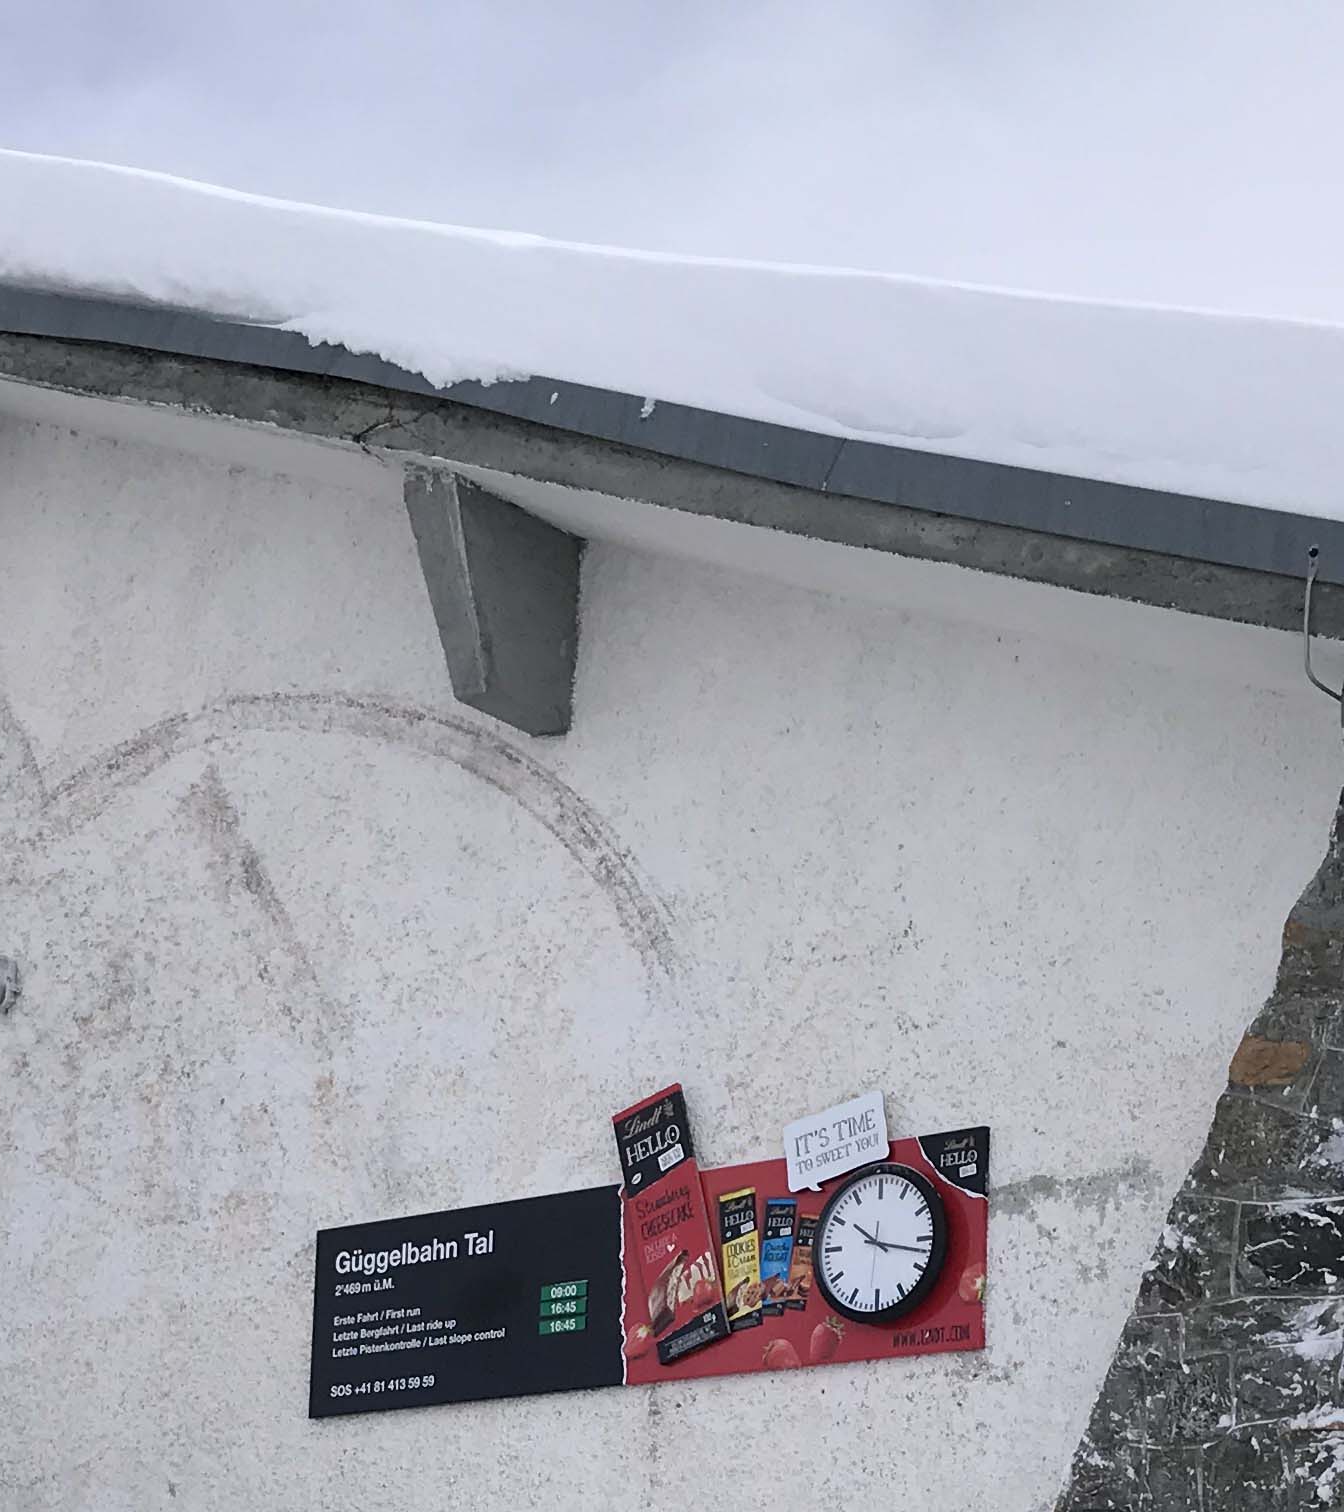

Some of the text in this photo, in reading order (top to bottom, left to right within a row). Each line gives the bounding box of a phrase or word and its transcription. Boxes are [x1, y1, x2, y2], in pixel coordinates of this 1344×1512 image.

[623, 1104, 662, 1140] Lindt
[793, 1108, 877, 1157] IT'S TIME
[626, 1124, 680, 1167] HELLO
[796, 1156, 814, 1175] TO
[816, 1142, 853, 1167] SWEET
[940, 1150, 978, 1167] HELLO
[724, 1210, 754, 1227] HELLO
[768, 1217, 794, 1227] HELLO
[335, 1230, 494, 1276] Güggelbahn Tal
[550, 1285, 577, 1298] 09:00
[333, 1315, 355, 1326] Erste
[357, 1312, 378, 1323] Fahrt
[386, 1308, 405, 1319] First
[406, 1307, 421, 1317] run
[550, 1302, 577, 1314] 16:45
[333, 1330, 358, 1342] Letzte
[360, 1325, 399, 1341] Bergfahrt
[406, 1321, 424, 1333] Last
[426, 1319, 443, 1331] ride
[445, 1319, 457, 1331] up
[549, 1319, 576, 1333] 16:45
[332, 1345, 357, 1358] Letzte
[359, 1339, 422, 1356] Pistenkontrolle
[429, 1335, 447, 1347] Last
[449, 1331, 472, 1346] slope
[474, 1328, 505, 1342] control
[330, 1375, 435, 1397] SOS +41 81 413 59 59
